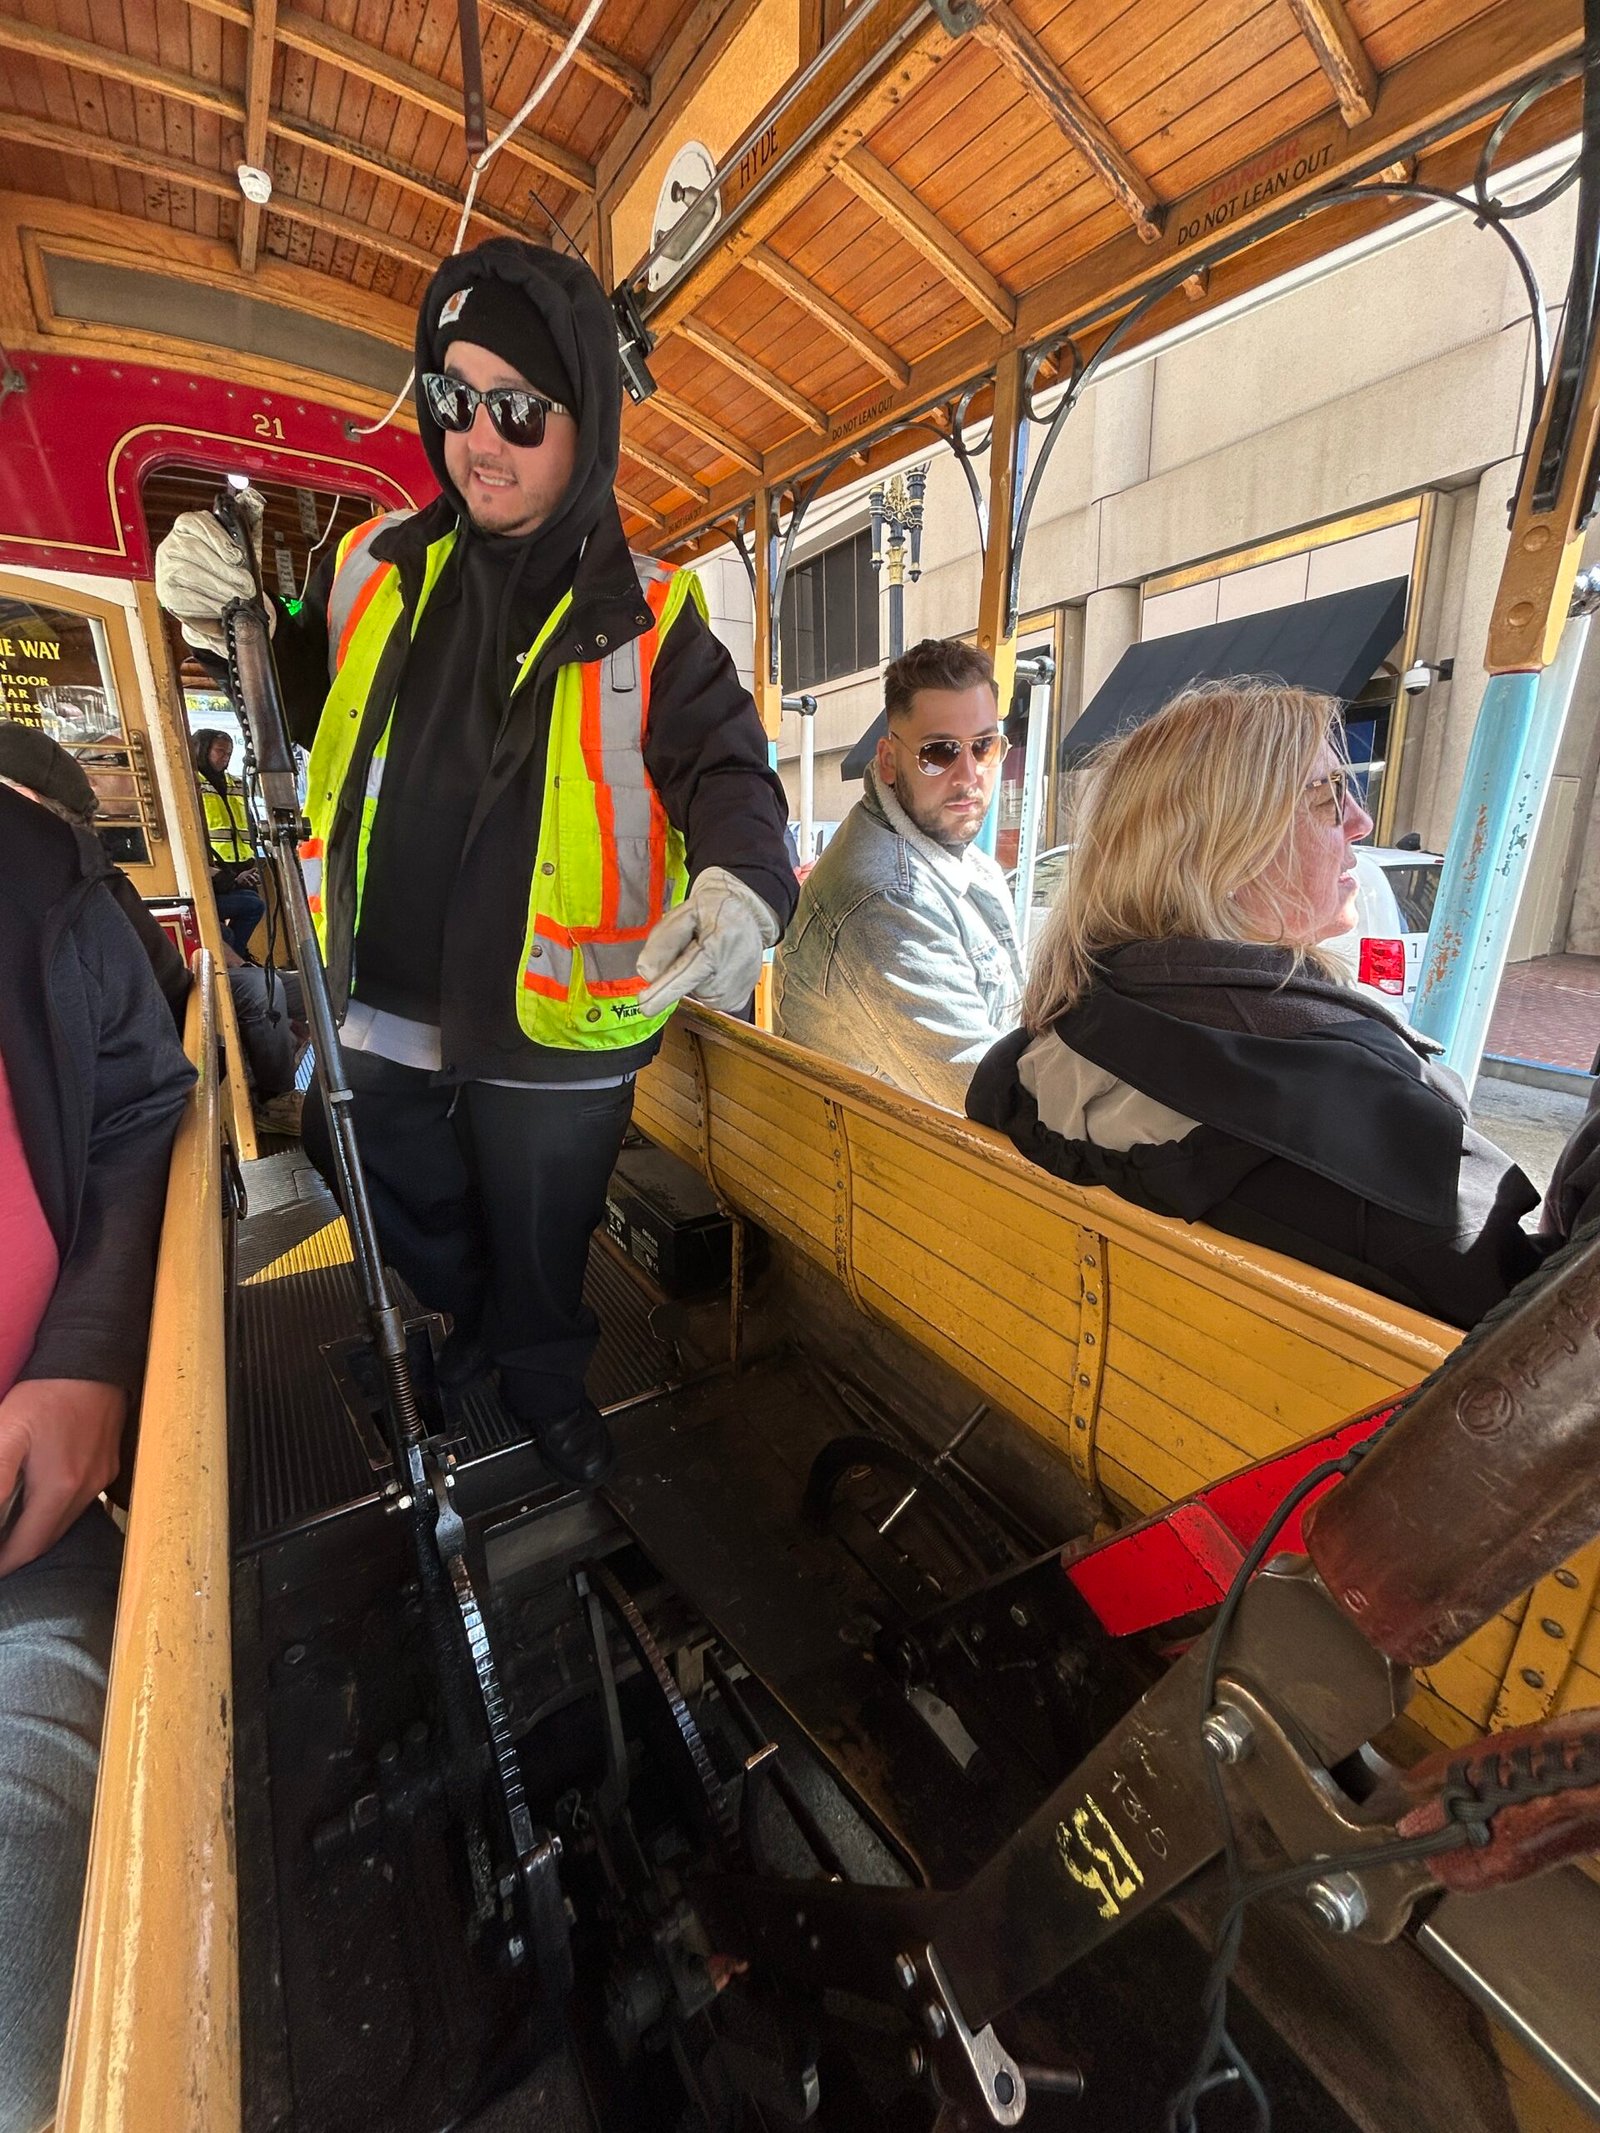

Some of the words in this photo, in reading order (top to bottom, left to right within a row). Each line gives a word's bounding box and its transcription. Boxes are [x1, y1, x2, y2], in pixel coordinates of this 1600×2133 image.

[740, 124, 779, 190] HYDE
[1177, 219, 1200, 246] DO
[1203, 196, 1239, 233] NOT
[1242, 168, 1289, 210] LEAN
[1292, 143, 1333, 181] OUT
[252, 413, 286, 440] 21
[831, 426, 842, 441] DO
[843, 416, 858, 434] NOT
[858, 405, 878, 426] LEAN
[878, 395, 894, 414] OUT
[18, 639, 61, 661] WAY
[1, 673, 50, 687] FLOOR
[1056, 1793, 1145, 1919] 135
